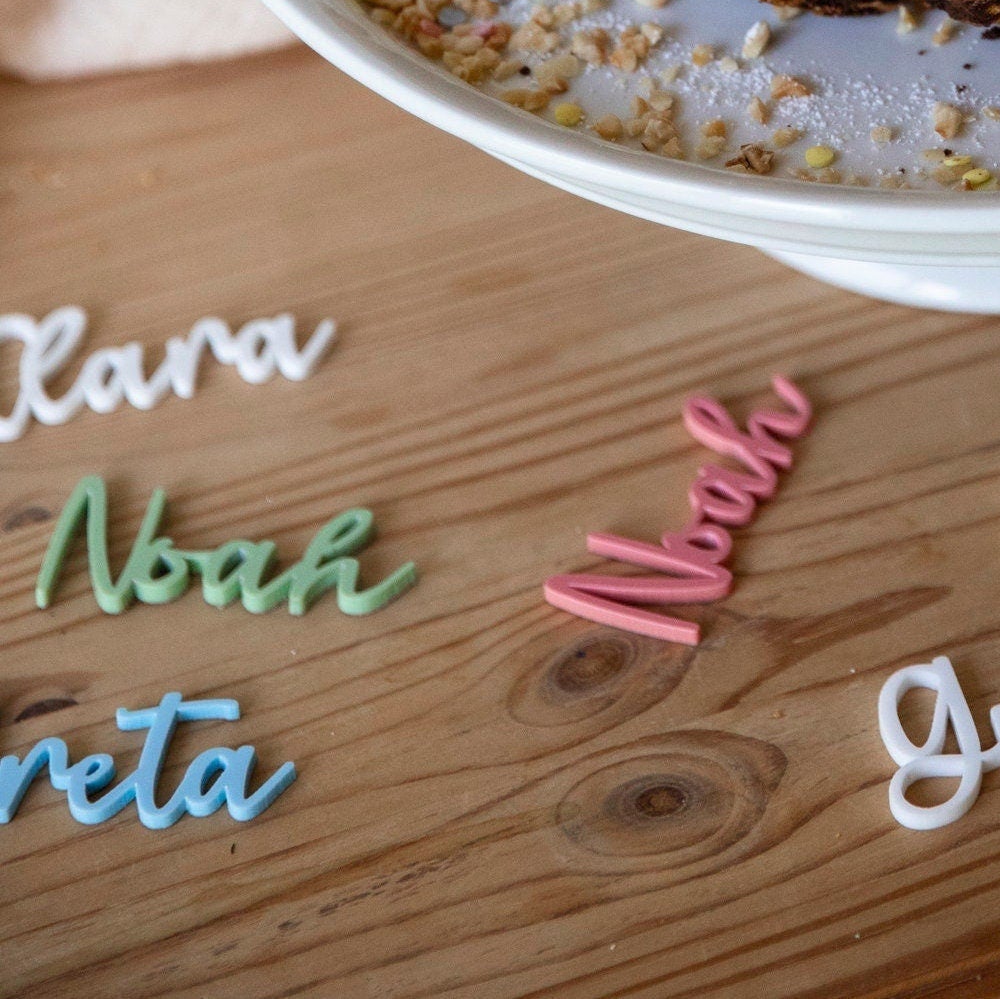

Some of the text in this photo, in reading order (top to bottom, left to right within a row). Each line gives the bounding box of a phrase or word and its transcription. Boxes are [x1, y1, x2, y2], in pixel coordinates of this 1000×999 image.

[35, 474, 417, 615] Noah
[543, 374, 814, 646] Noah
[0, 691, 297, 830] reta
